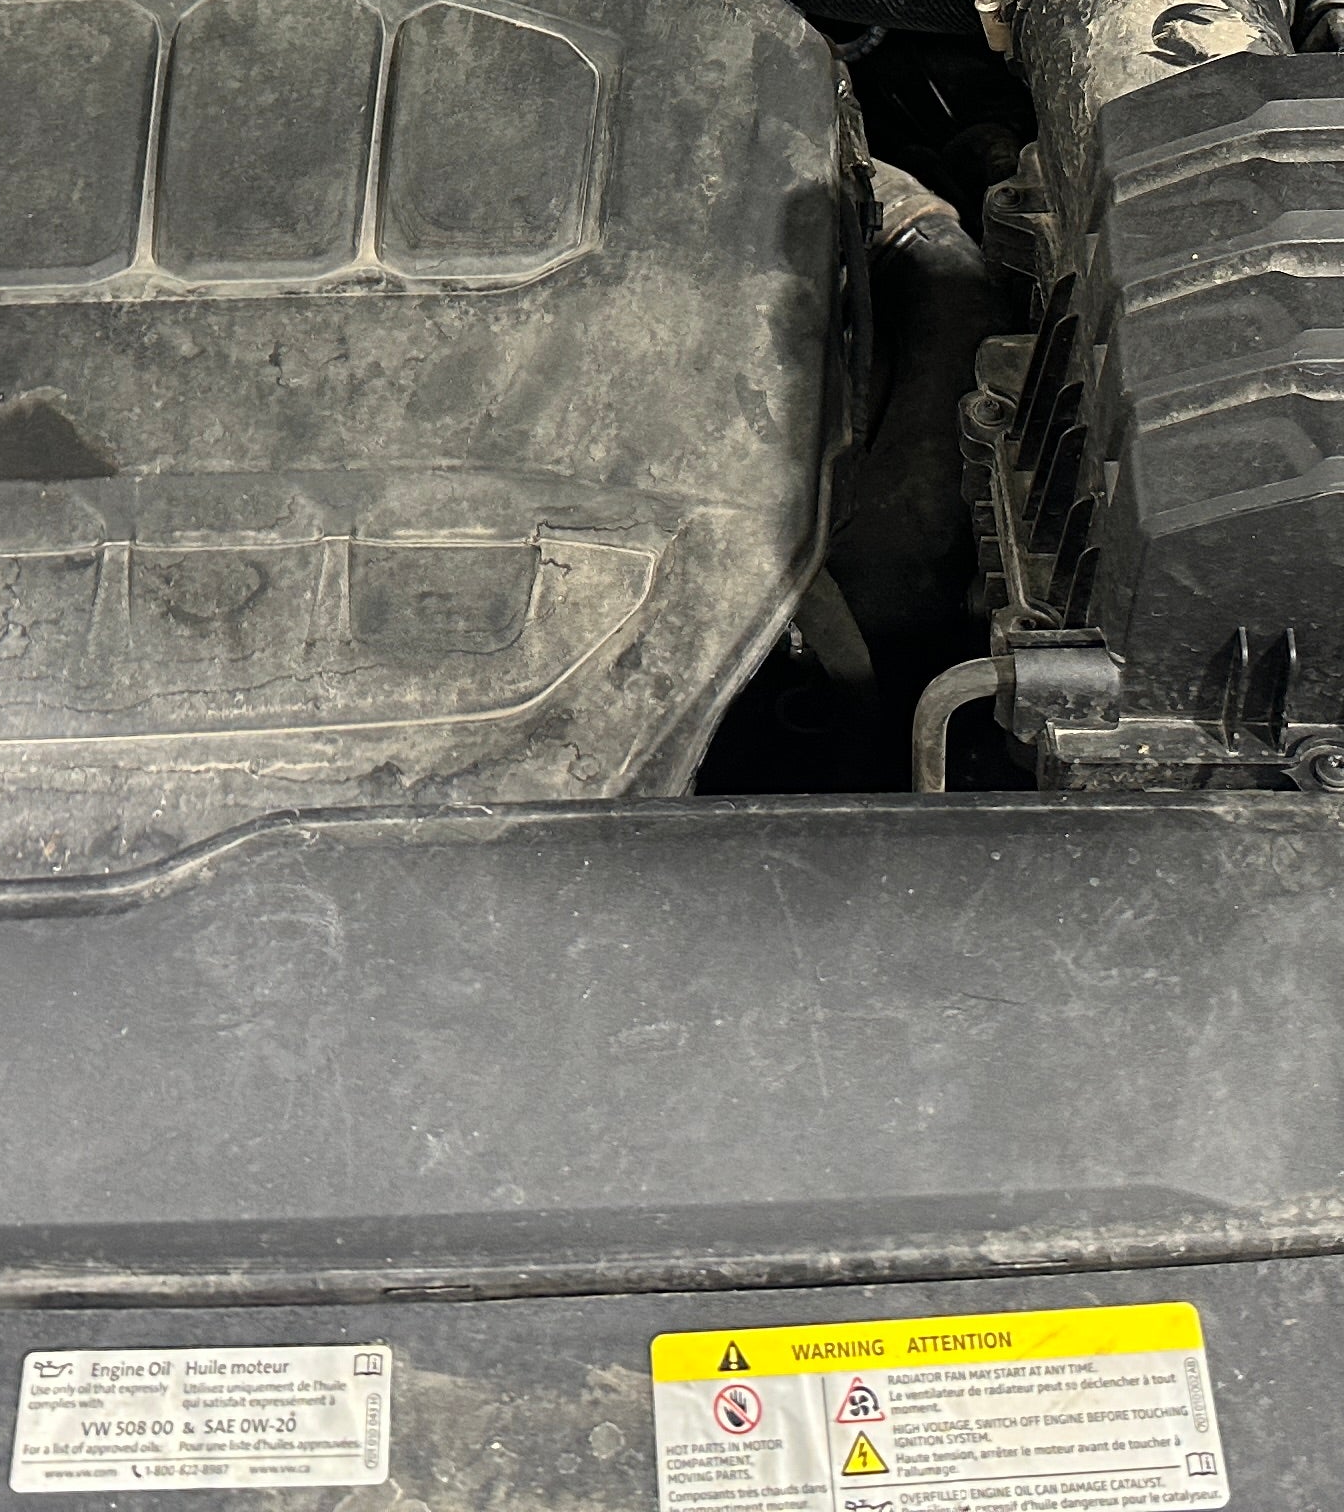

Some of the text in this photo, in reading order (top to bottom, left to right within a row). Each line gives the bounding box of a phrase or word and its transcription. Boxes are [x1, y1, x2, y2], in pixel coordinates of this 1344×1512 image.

[791, 1331, 1013, 1361] WARNING ATTENTION
[91, 1360, 172, 1381] Engine Oil
[184, 1359, 290, 1376] Huile moteur
[887, 1371, 942, 1385] RADIATOR
[944, 1370, 967, 1382] FAN
[968, 1369, 993, 1381] MAY
[993, 1367, 1027, 1380] START
[1028, 1365, 1042, 1377] AT
[1044, 1364, 1066, 1376] ANY
[30, 1384, 49, 1396] Use
[49, 1383, 76, 1398] only
[77, 1382, 92, 1394] oil
[93, 1382, 117, 1394] that
[297, 1380, 311, 1392] de
[889, 1391, 903, 1402] Le
[904, 1387, 965, 1400] ventilateur
[967, 1385, 982, 1397] de
[983, 1383, 1034, 1396] radiateur
[1037, 1382, 1063, 1395] peut
[1151, 1373, 1177, 1385] tout
[182, 1397, 201, 1411] qui
[81, 1417, 297, 1436] VW 508 00 & SAE 0W-20
[892, 1423, 920, 1435] HIGH
[974, 1417, 1018, 1430] SWITCH
[1019, 1415, 1041, 1427] OFF
[1043, 1412, 1085, 1426] ENGINE
[1086, 1409, 1130, 1423] BEFORE
[1131, 1405, 1189, 1420] TOUCHING
[22, 1443, 40, 1455] For
[53, 1442, 70, 1455] list
[71, 1441, 84, 1454] of
[666, 1439, 783, 1456] HOT PARTS IN MOTOR
[894, 1434, 944, 1448] IGNITION
[895, 1452, 930, 1464] Haute
[980, 1445, 1018, 1459] arrêter
[1020, 1445, 1031, 1456] le
[1034, 1443, 1075, 1455] moteur
[1077, 1441, 1109, 1453] avant
[1111, 1439, 1126, 1451] de
[1128, 1436, 1171, 1450] toucher
[668, 1471, 714, 1484] MOVING
[668, 1488, 736, 1503] Composants
[761, 1484, 800, 1497] chauds
[801, 1482, 828, 1495] dans
[899, 1489, 967, 1505] OVERFILLED
[970, 1486, 1012, 1500] ENGINE
[1014, 1485, 1034, 1497] OIL
[1035, 1483, 1058, 1495] CAN
[1060, 1480, 1108, 1494] DAMAGE
[1060, 1496, 1120, 1510] dangereux
[1122, 1493, 1147, 1506] pour
[1149, 1492, 1160, 1503] le
